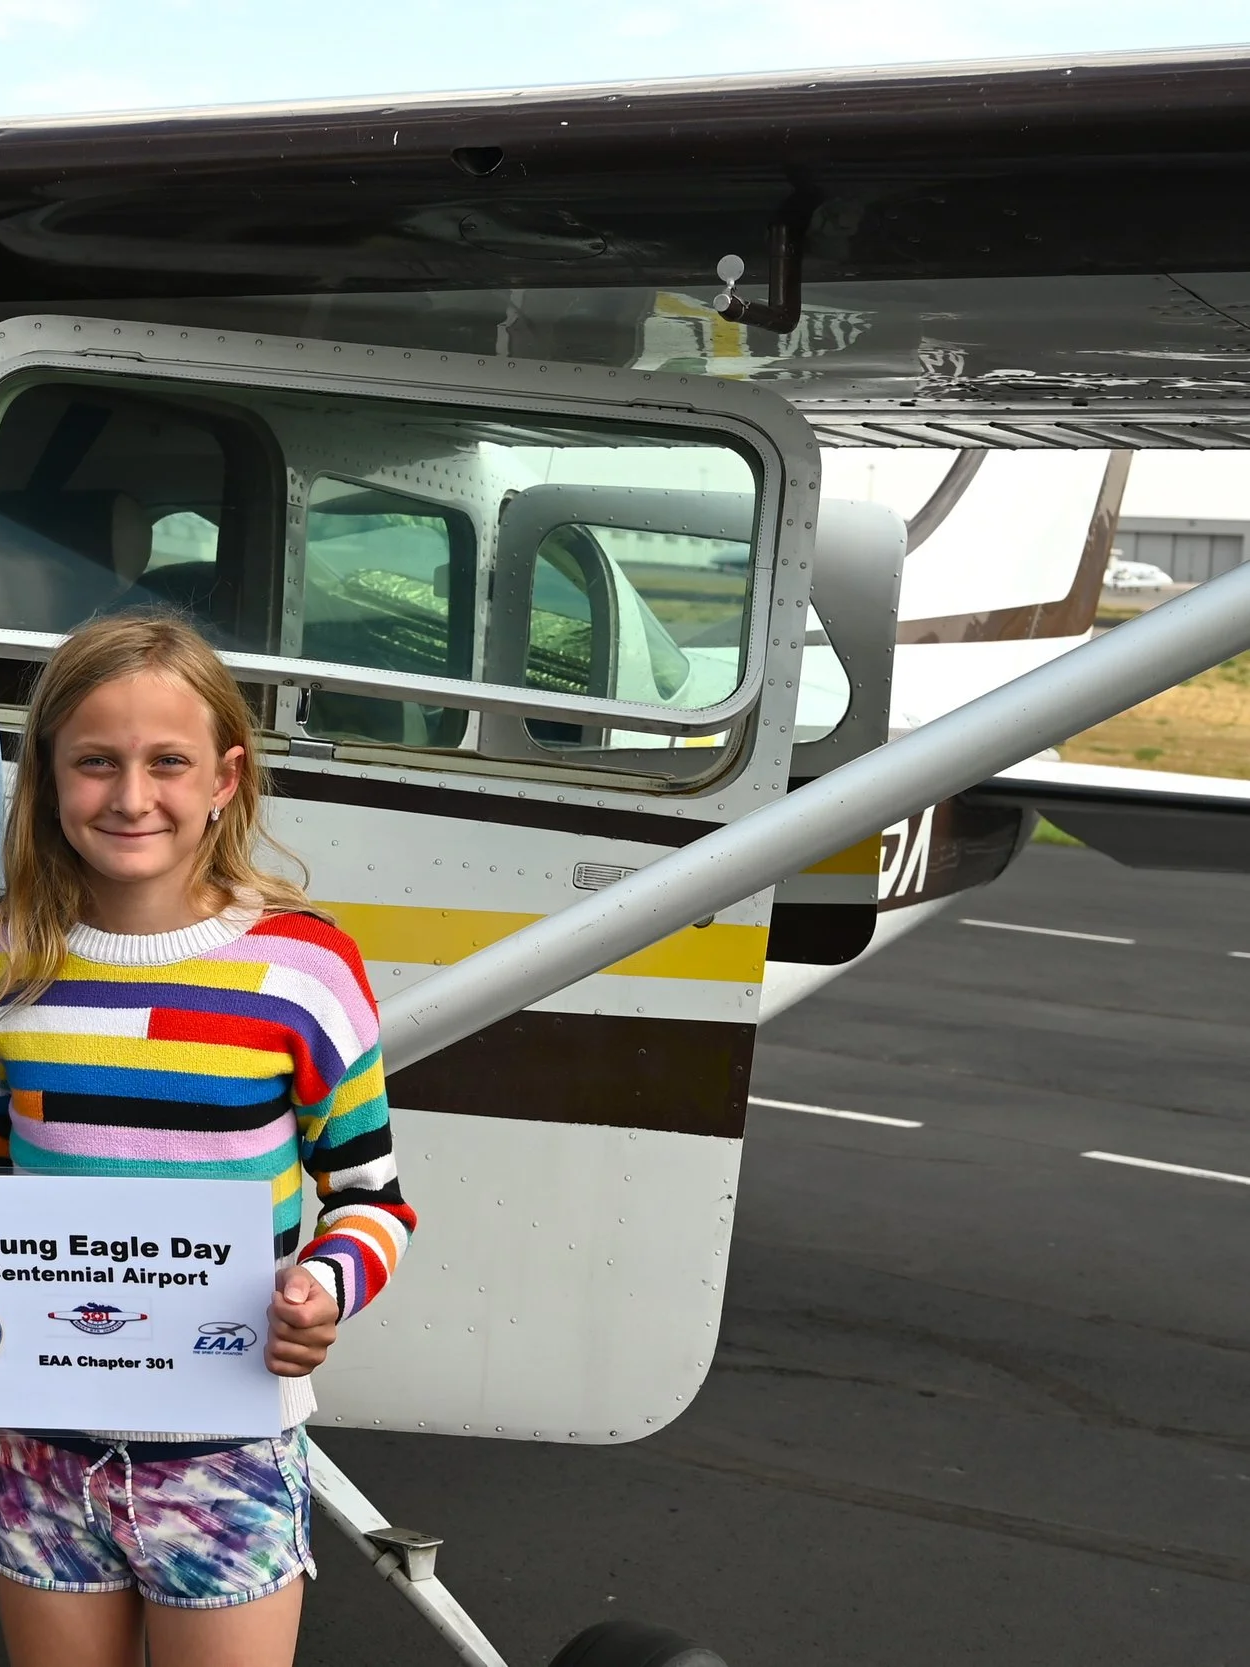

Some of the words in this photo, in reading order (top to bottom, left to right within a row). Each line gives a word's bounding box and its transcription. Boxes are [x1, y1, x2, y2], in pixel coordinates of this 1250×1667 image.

[69, 1235, 159, 1262] Eagle
[171, 1237, 231, 1265] Day
[122, 1267, 208, 1288] Airport
[193, 1336, 244, 1351] EAA
[39, 1355, 72, 1366] EAA
[77, 1356, 141, 1370] Chapter
[146, 1358, 173, 1369] 301
